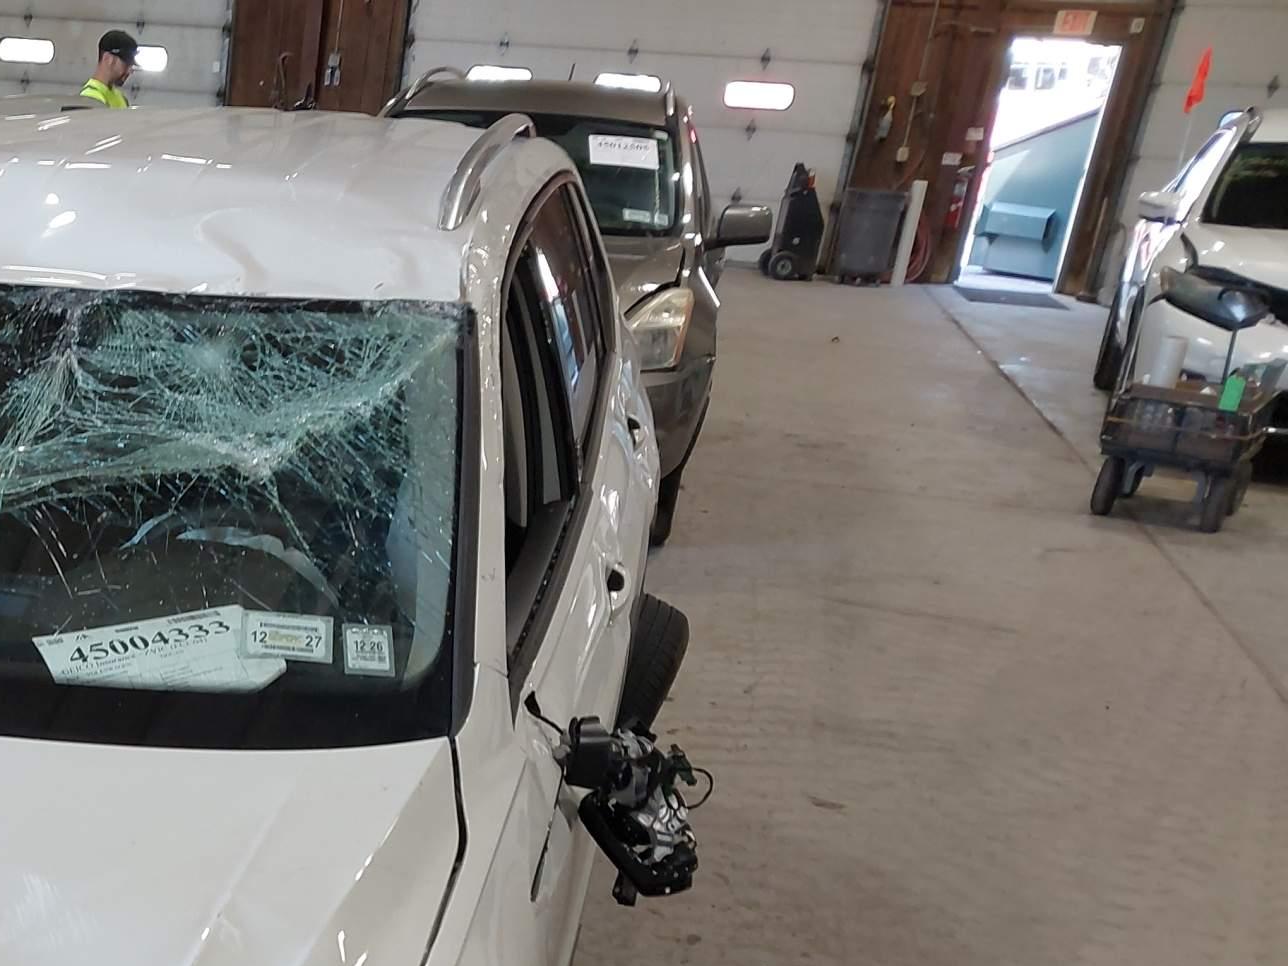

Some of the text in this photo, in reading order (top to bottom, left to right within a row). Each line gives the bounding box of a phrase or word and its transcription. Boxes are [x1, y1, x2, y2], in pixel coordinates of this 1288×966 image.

[69, 620, 231, 665] 45004333
[251, 630, 268, 644] 12
[305, 635, 322, 649] 27
[353, 639, 366, 652] 12
